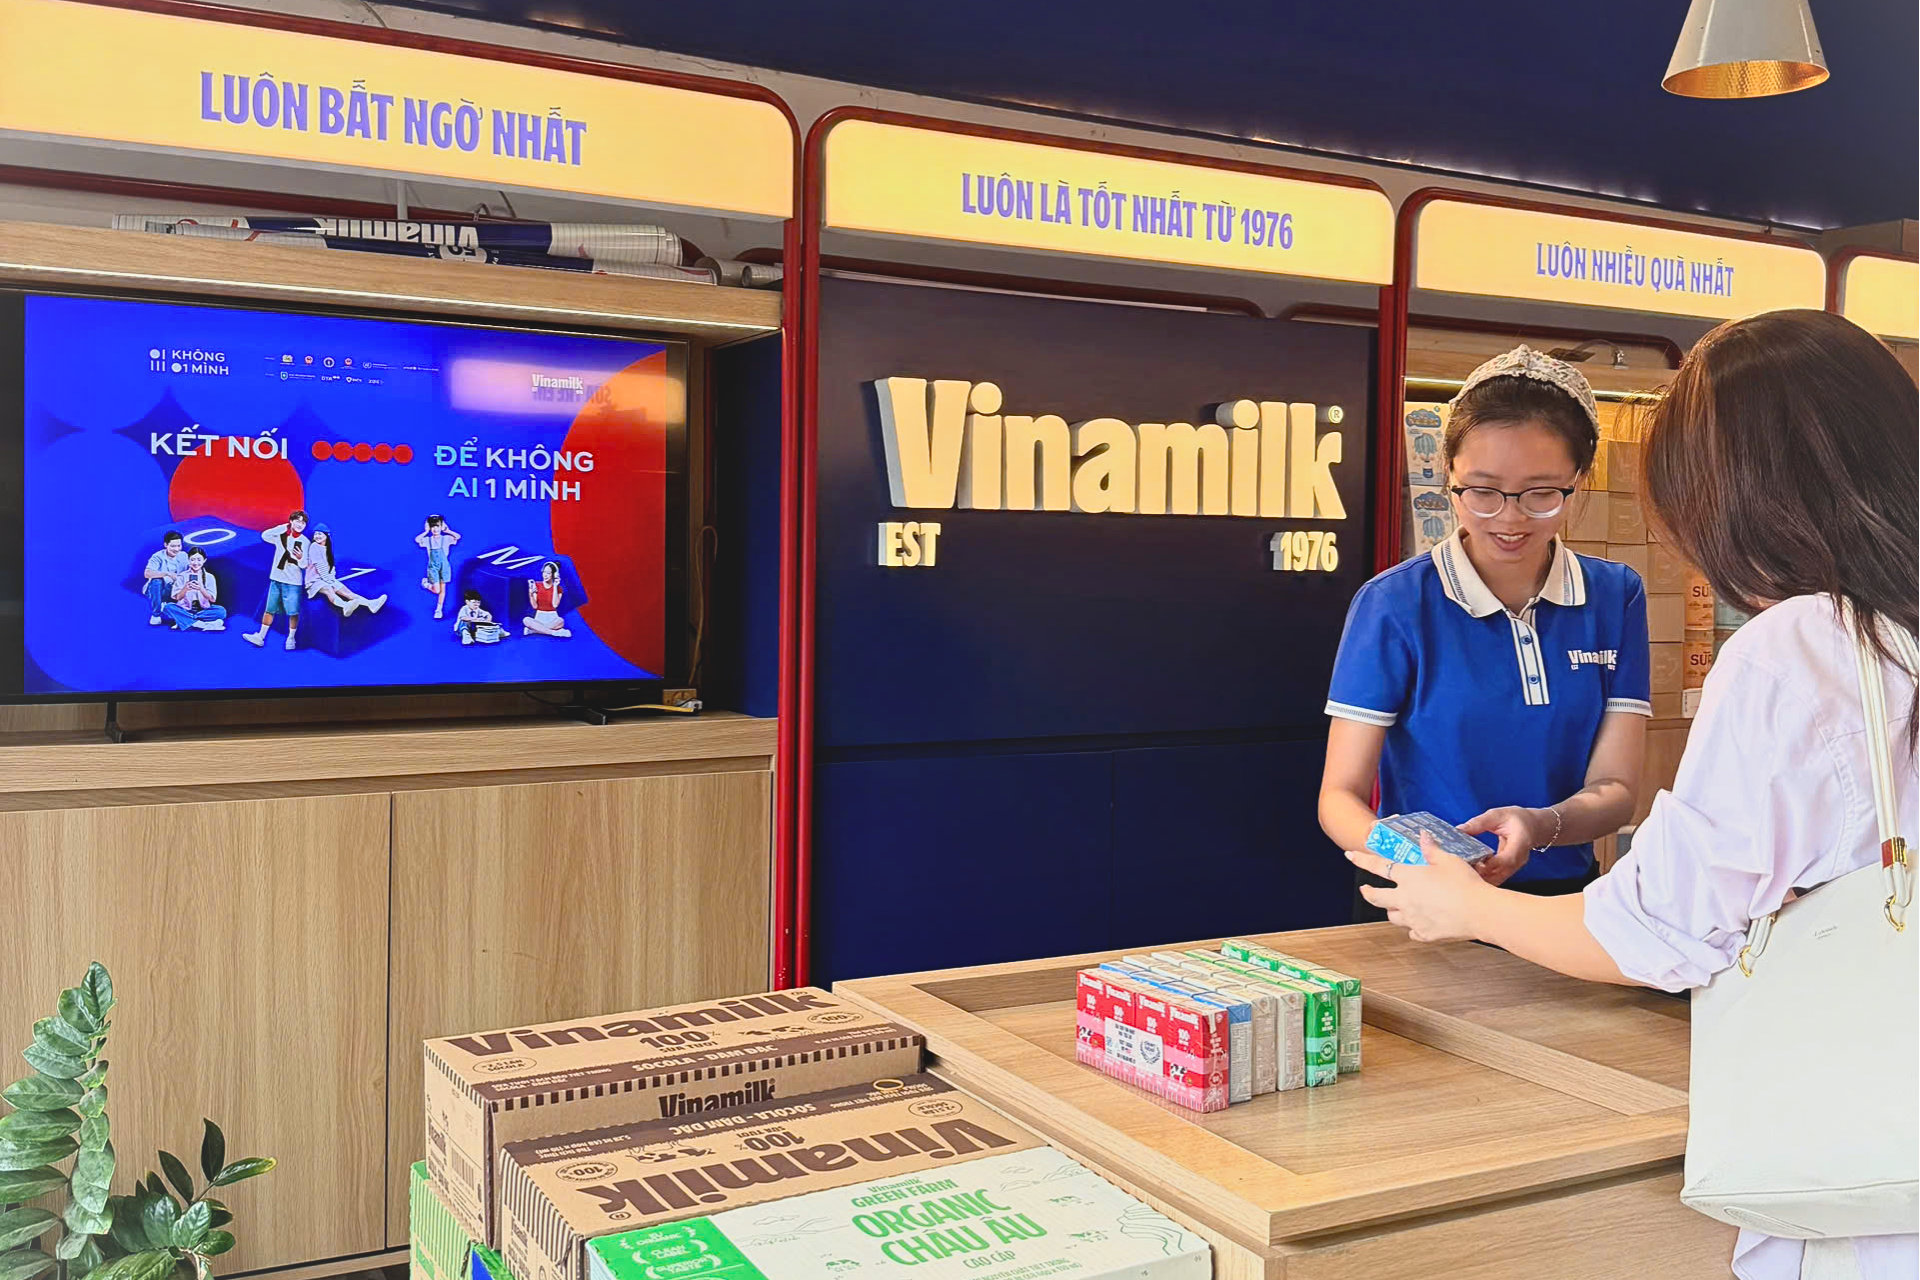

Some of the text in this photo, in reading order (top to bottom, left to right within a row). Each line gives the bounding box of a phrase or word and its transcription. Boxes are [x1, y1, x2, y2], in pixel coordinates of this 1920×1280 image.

[200, 71, 587, 166] LUÔN BẤT NGỜ NHẤT
[962, 172, 1293, 250] LUÔN LÀ TỐT NHẤT TỪ 1976
[313, 217, 479, 250] Vinamilk
[1536, 240, 1735, 298] LUÔN NHIỀU QUÀ NHẤT
[171, 349, 225, 363] KHÔNG
[191, 362, 229, 376] MÌNH
[151, 424, 288, 460] KẾT NỐI
[434, 436, 595, 473] ĐỂ KHÔNG
[448, 474, 581, 501] AI 1 MÌNH
[880, 521, 1338, 572] EST 1976
[632, 1056, 696, 1072] SOCOLA
[754, 1103, 817, 1120] SOCOLA
[851, 1179, 959, 1207] GREEN FARM
[867, 1176, 922, 1193] Vinamilk
[852, 1188, 1012, 1238] ORGANIC
[881, 1213, 1048, 1266] CHÂU ÂU
[963, 1256, 992, 1269] CAO
